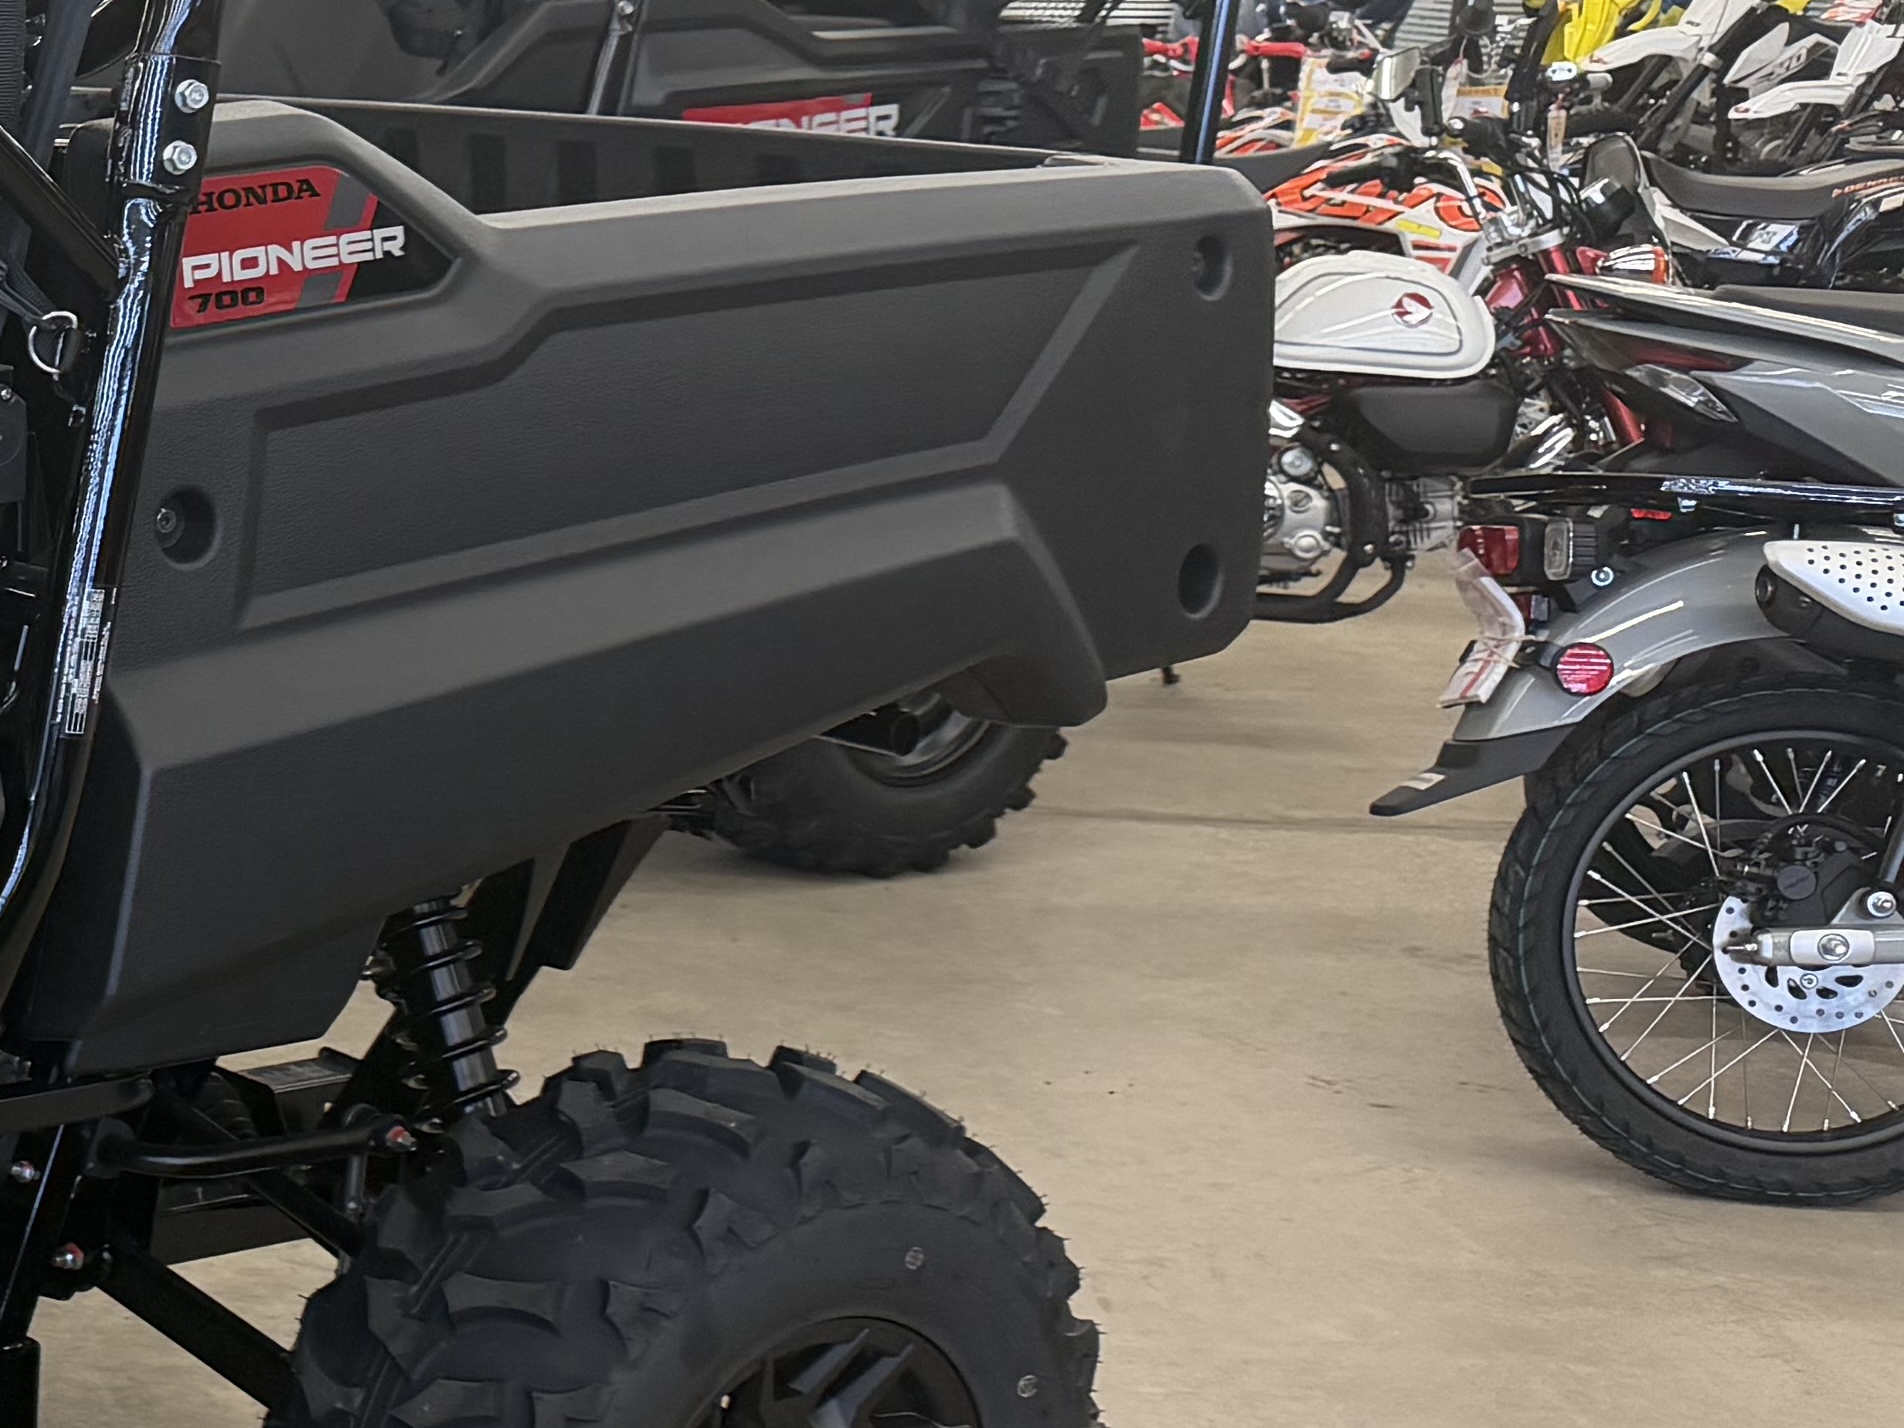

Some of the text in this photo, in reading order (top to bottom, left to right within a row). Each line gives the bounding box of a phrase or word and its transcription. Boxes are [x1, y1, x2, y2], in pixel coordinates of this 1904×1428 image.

[189, 178, 321, 215] HONDA
[182, 225, 406, 288] PIONEER
[188, 285, 266, 313] 700
